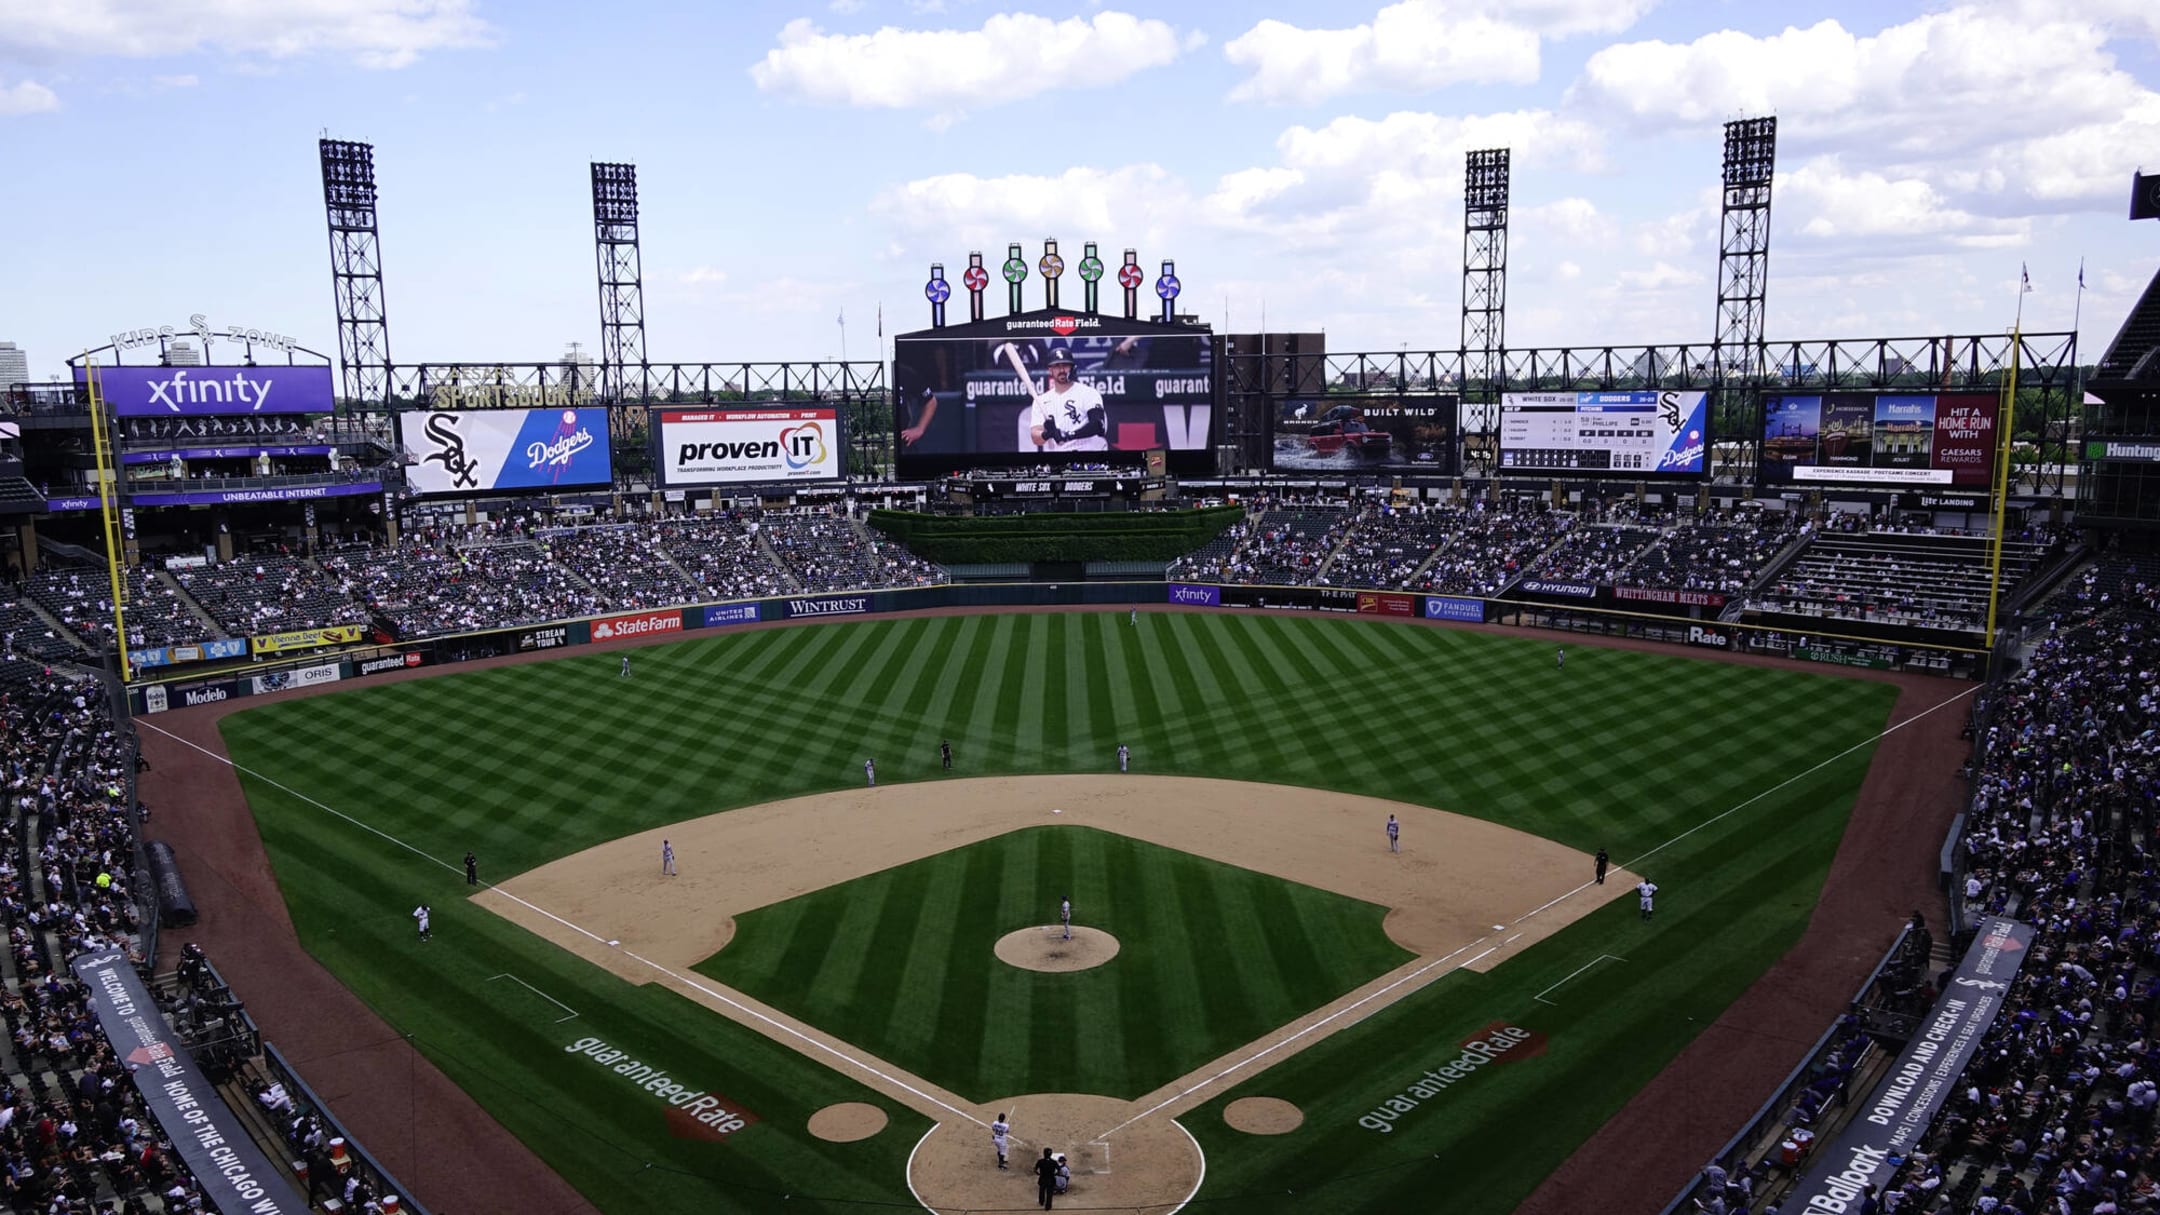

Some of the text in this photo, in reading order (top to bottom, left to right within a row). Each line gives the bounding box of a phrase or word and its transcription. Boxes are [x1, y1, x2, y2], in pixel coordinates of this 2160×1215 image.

[1006, 318, 1054, 330] guaranteed
[1055, 318, 1074, 328] Rate
[110, 326, 297, 353] KIDS ZONE
[434, 367, 516, 380] CAESARS
[147, 371, 272, 412] xfinity
[436, 384, 570, 408] SPORTSBOOK
[966, 376, 1044, 400] guaranted
[1364, 408, 1399, 416] BUILT
[1938, 417, 1991, 430] HOME RUN
[1949, 430, 1978, 439] WITH
[527, 426, 593, 468] Dodgers
[678, 436, 814, 465] proven IT
[1940, 448, 1982, 457] CAESARS
[1016, 481, 1094, 491] WHITE SOX DODGERS
[222, 488, 327, 501] UNBEATABLE INTERNET
[1921, 497, 1938, 506] Lite
[62, 499, 88, 509] xfinity
[1175, 587, 1212, 603] xfinity
[1542, 583, 1590, 595] HYUNDAI
[1616, 586, 1708, 605] WHITTINGHAM MEATS
[790, 598, 866, 614] WINTRUST
[1444, 602, 1480, 612] FANDUEL
[709, 613, 744, 621] AIRLINES
[270, 633, 301, 644] Vienna
[302, 631, 321, 642] Beef
[536, 628, 565, 639] STREAM
[1690, 626, 1727, 646] Rate
[536, 638, 556, 648] YOUR
[362, 653, 421, 674] guaranteed Rate
[1820, 653, 1847, 664] RUSH
[305, 667, 332, 680] ORIS
[186, 687, 227, 706] Modelo
[97, 968, 136, 1016] WELCOME TO
[1969, 995, 1993, 1022] UPGRADES
[1961, 1021, 1978, 1036] SEAT
[1935, 1040, 1968, 1077] EXPERIENCES
[155, 1056, 185, 1078] Field
[565, 1037, 745, 1133] guaranteed Rate
[1358, 1026, 1531, 1132] guaranteed Rate
[1868, 1060, 1924, 1125] DOWNLOAD
[1911, 1041, 1939, 1064] AND
[1904, 1079, 1943, 1123] CONCESSIONS
[162, 1080, 197, 1116] HOME
[183, 1108, 203, 1127] OF
[193, 1123, 223, 1152] THE
[209, 1146, 265, 1200] CHICAGO
[1888, 1126, 1911, 1146] MAPS
